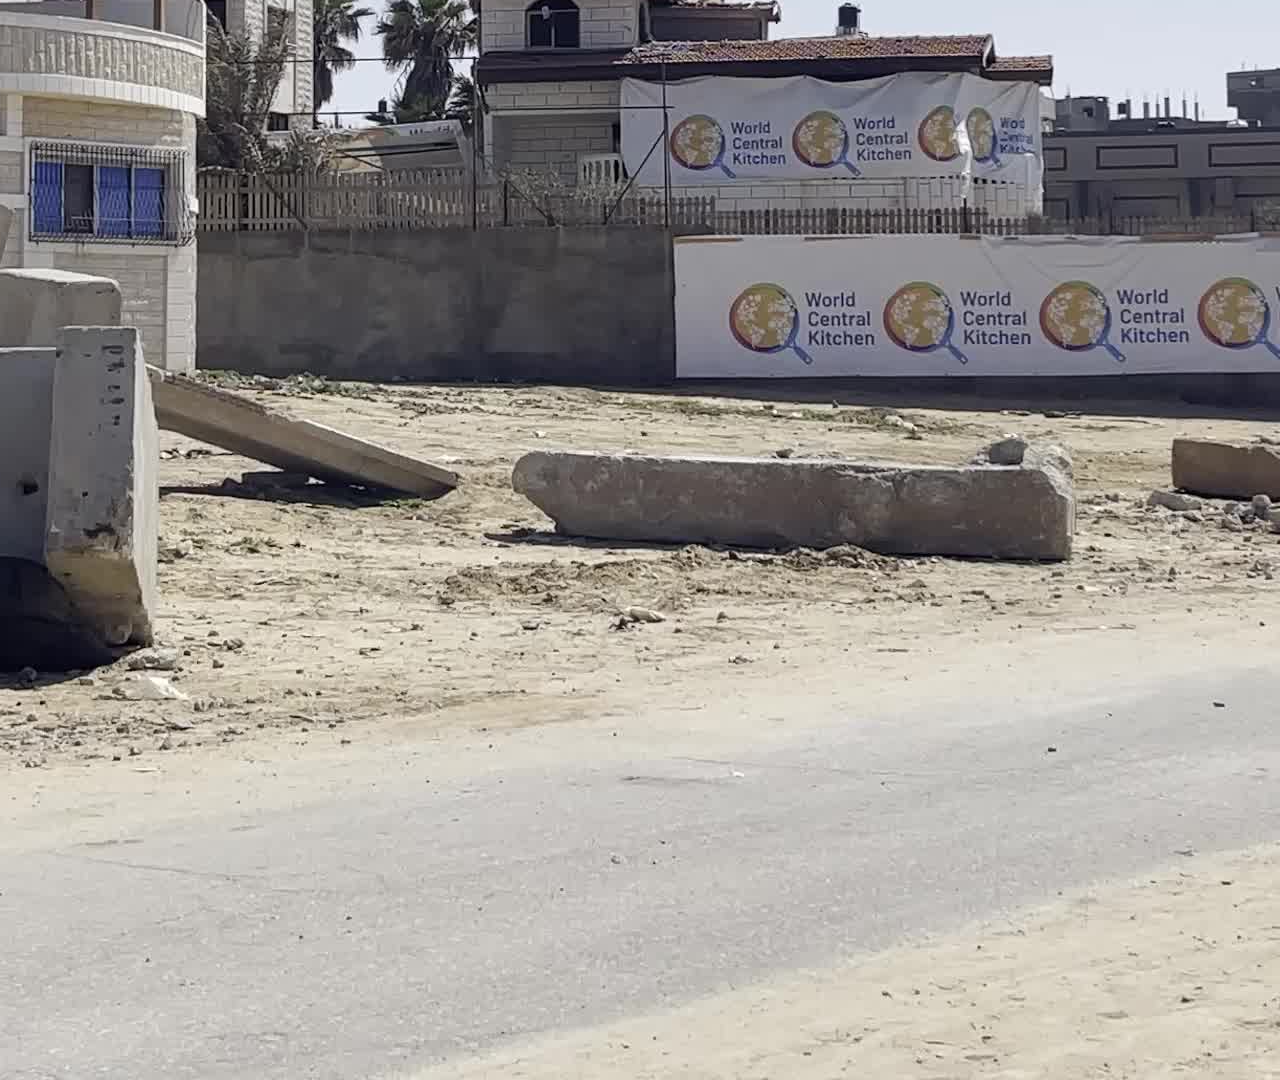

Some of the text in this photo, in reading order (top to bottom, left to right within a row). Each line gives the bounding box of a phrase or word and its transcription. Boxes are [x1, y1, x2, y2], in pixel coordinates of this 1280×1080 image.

[731, 122, 771, 135] World
[853, 117, 895, 130] World
[732, 136, 783, 150] Central
[856, 132, 908, 145] Central
[732, 152, 786, 165] Kitchen
[856, 147, 912, 161] Kitchen
[805, 292, 855, 307] World
[960, 291, 1011, 306] World
[1117, 289, 1168, 305] World
[808, 311, 871, 327] Central
[963, 311, 1027, 326] Central
[1120, 309, 1184, 325] Central
[808, 331, 875, 346] Kitchen
[963, 330, 1031, 345] Kitchen
[1120, 328, 1189, 344] Kitchen
